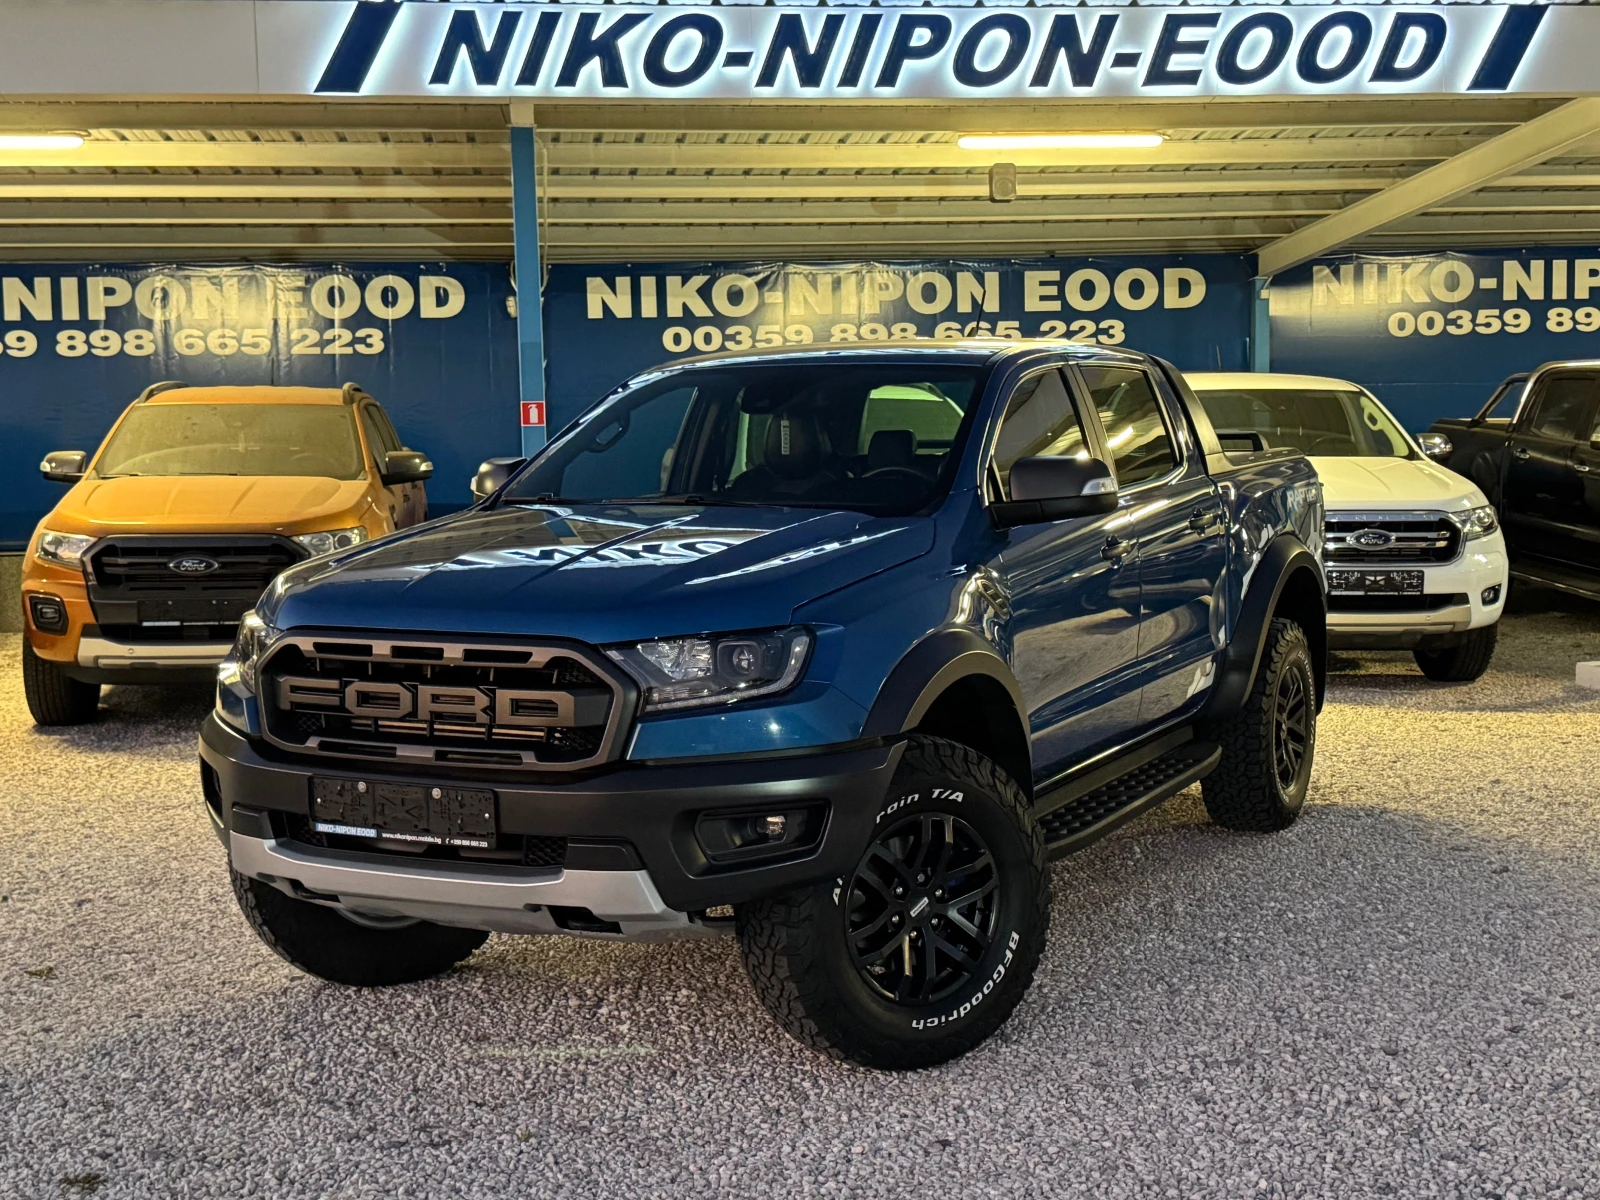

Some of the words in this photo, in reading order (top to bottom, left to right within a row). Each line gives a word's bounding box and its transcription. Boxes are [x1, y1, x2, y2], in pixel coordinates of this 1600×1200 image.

[428, 9, 1447, 89] NIKO-NIPON-EOOD
[2, 276, 240, 321] NIPON
[270, 274, 466, 321] EOOD
[586, 271, 1000, 319] NIKO-NIPON
[1024, 267, 1207, 312] EOOD
[662, 324, 814, 353] 00359
[830, 322, 918, 342] 898
[1039, 319, 1126, 345] 223
[1387, 308, 1531, 338] 00359
[1546, 306, 1600, 333] 89
[0, 329, 38, 358] 9
[55, 329, 156, 358] 898
[173, 328, 271, 356] 665
[290, 327, 385, 355] 223
[1360, 533, 1385, 545] Ford
[179, 559, 207, 571] Ford
[279, 677, 576, 727] FORD
[876, 793, 919, 824] rain
[931, 788, 965, 803] T/A
[316, 822, 357, 836] NIKO-NIPON
[357, 827, 376, 838] EOOD
[911, 930, 1020, 1031] BFGoodrich
